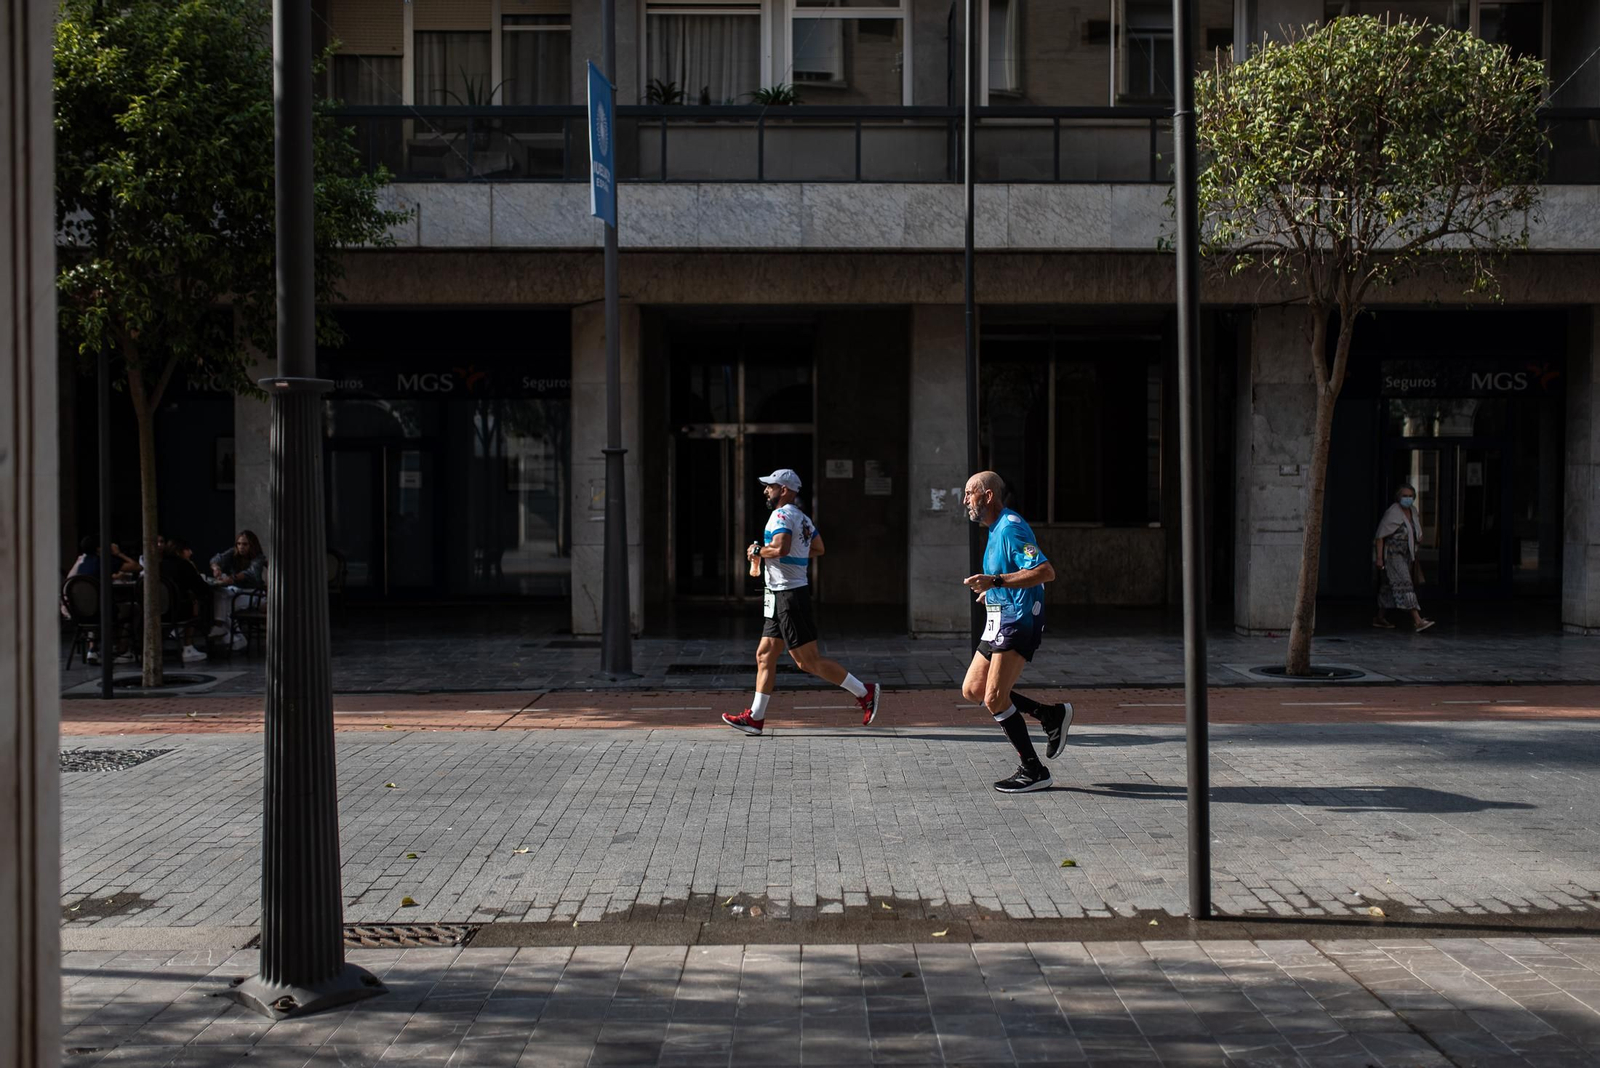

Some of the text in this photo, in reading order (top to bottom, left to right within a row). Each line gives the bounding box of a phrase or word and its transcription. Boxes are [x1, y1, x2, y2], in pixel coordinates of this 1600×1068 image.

[397, 373, 454, 392] MGS
[1385, 376, 1437, 392] Seguros
[1471, 372, 1528, 391] MGS
